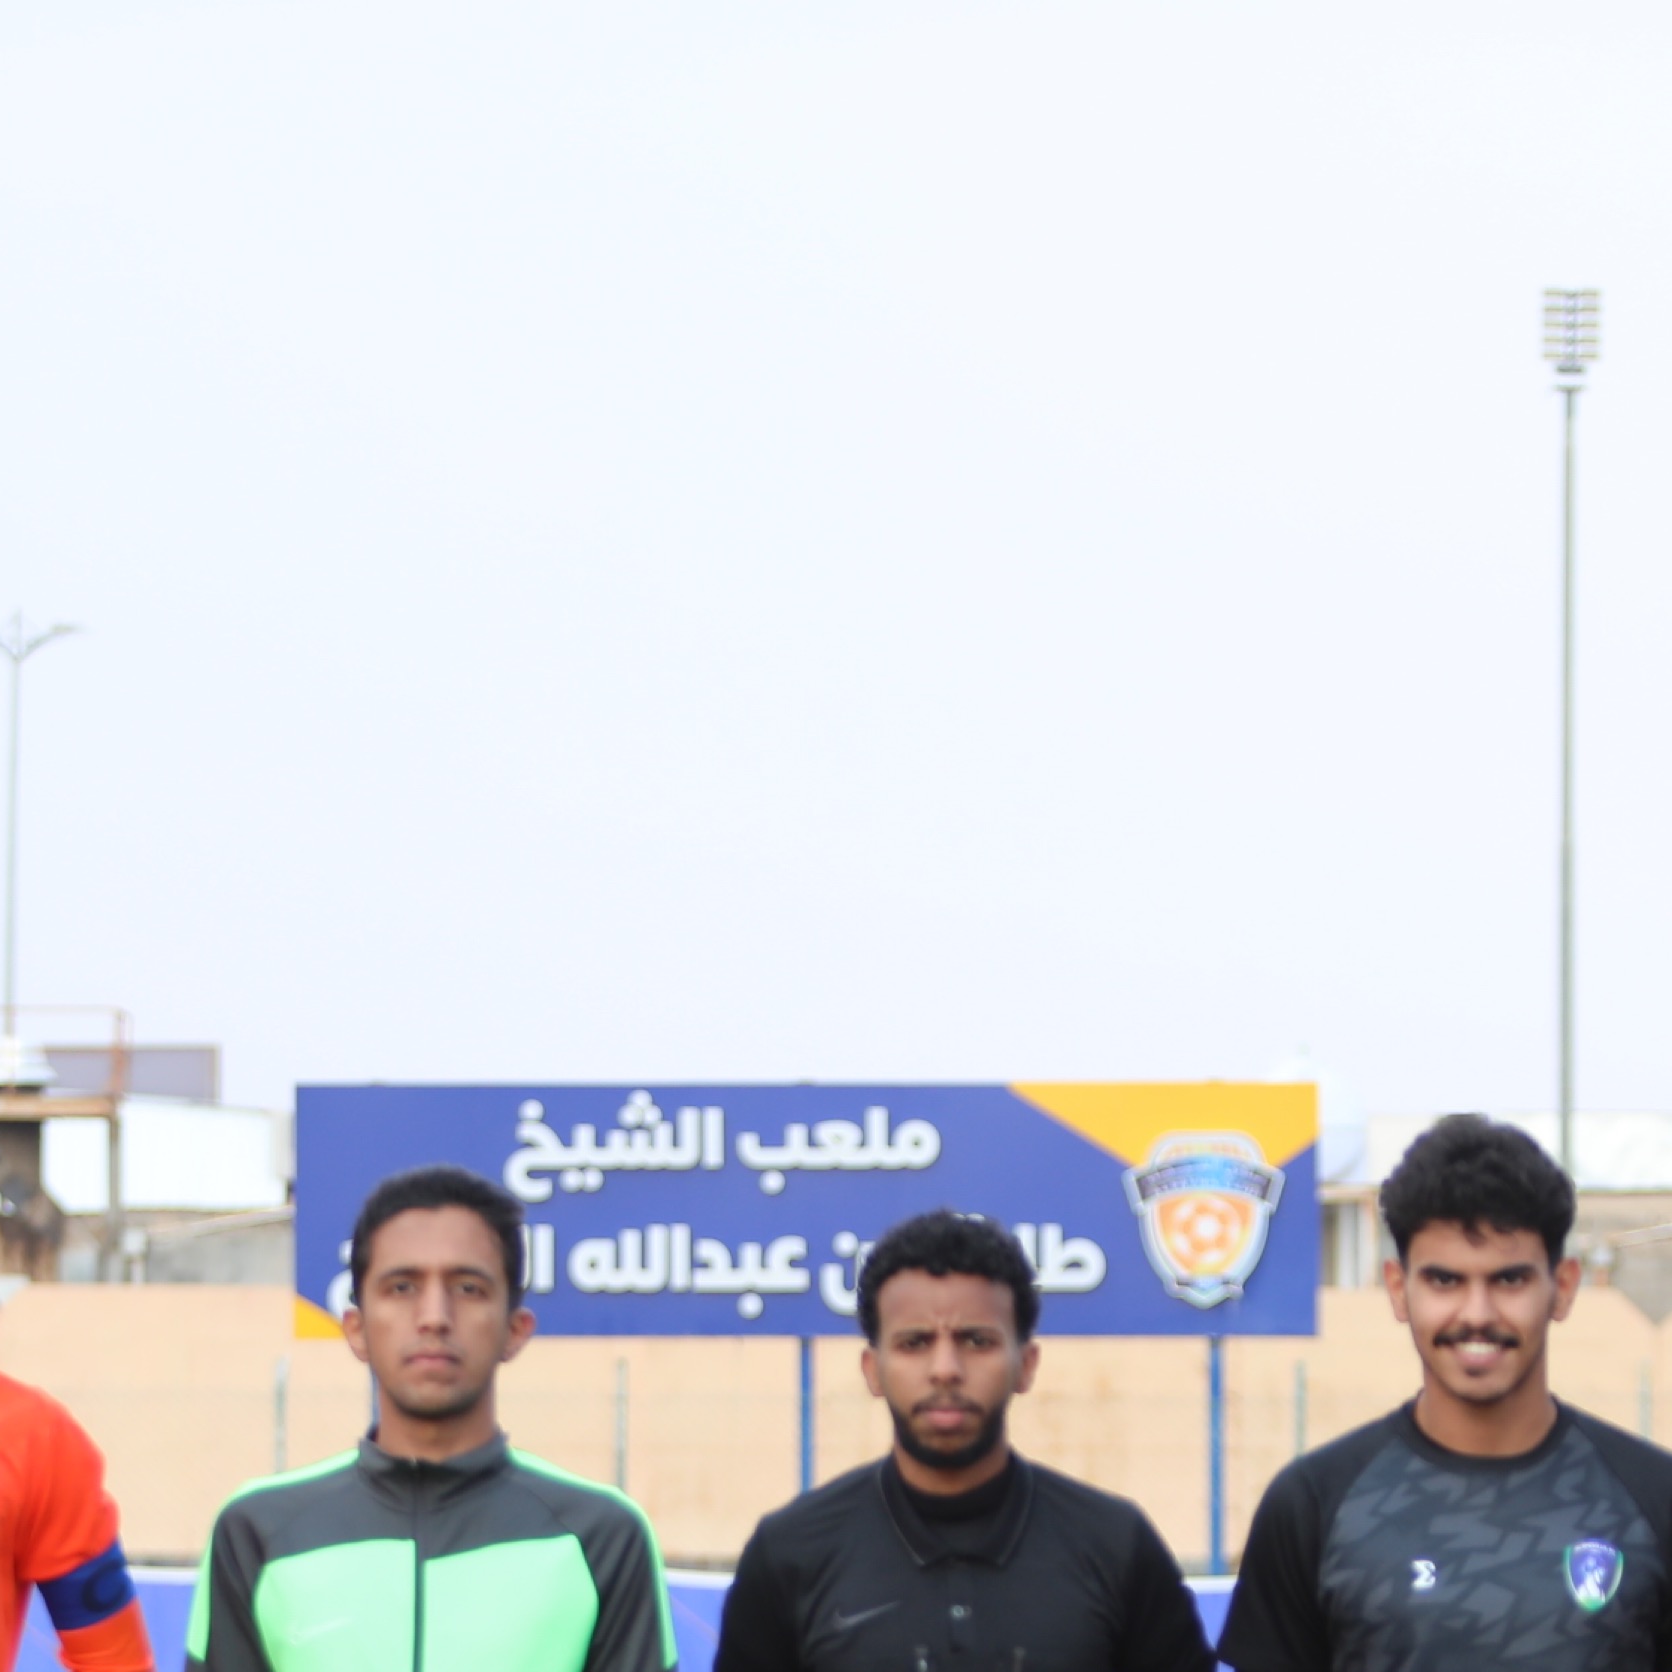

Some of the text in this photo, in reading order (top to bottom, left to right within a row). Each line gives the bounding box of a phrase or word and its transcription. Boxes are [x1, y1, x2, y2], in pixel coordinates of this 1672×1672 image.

[502, 1089, 942, 1204] ملعب الشيخ
[566, 1222, 811, 1320] عبدالله
